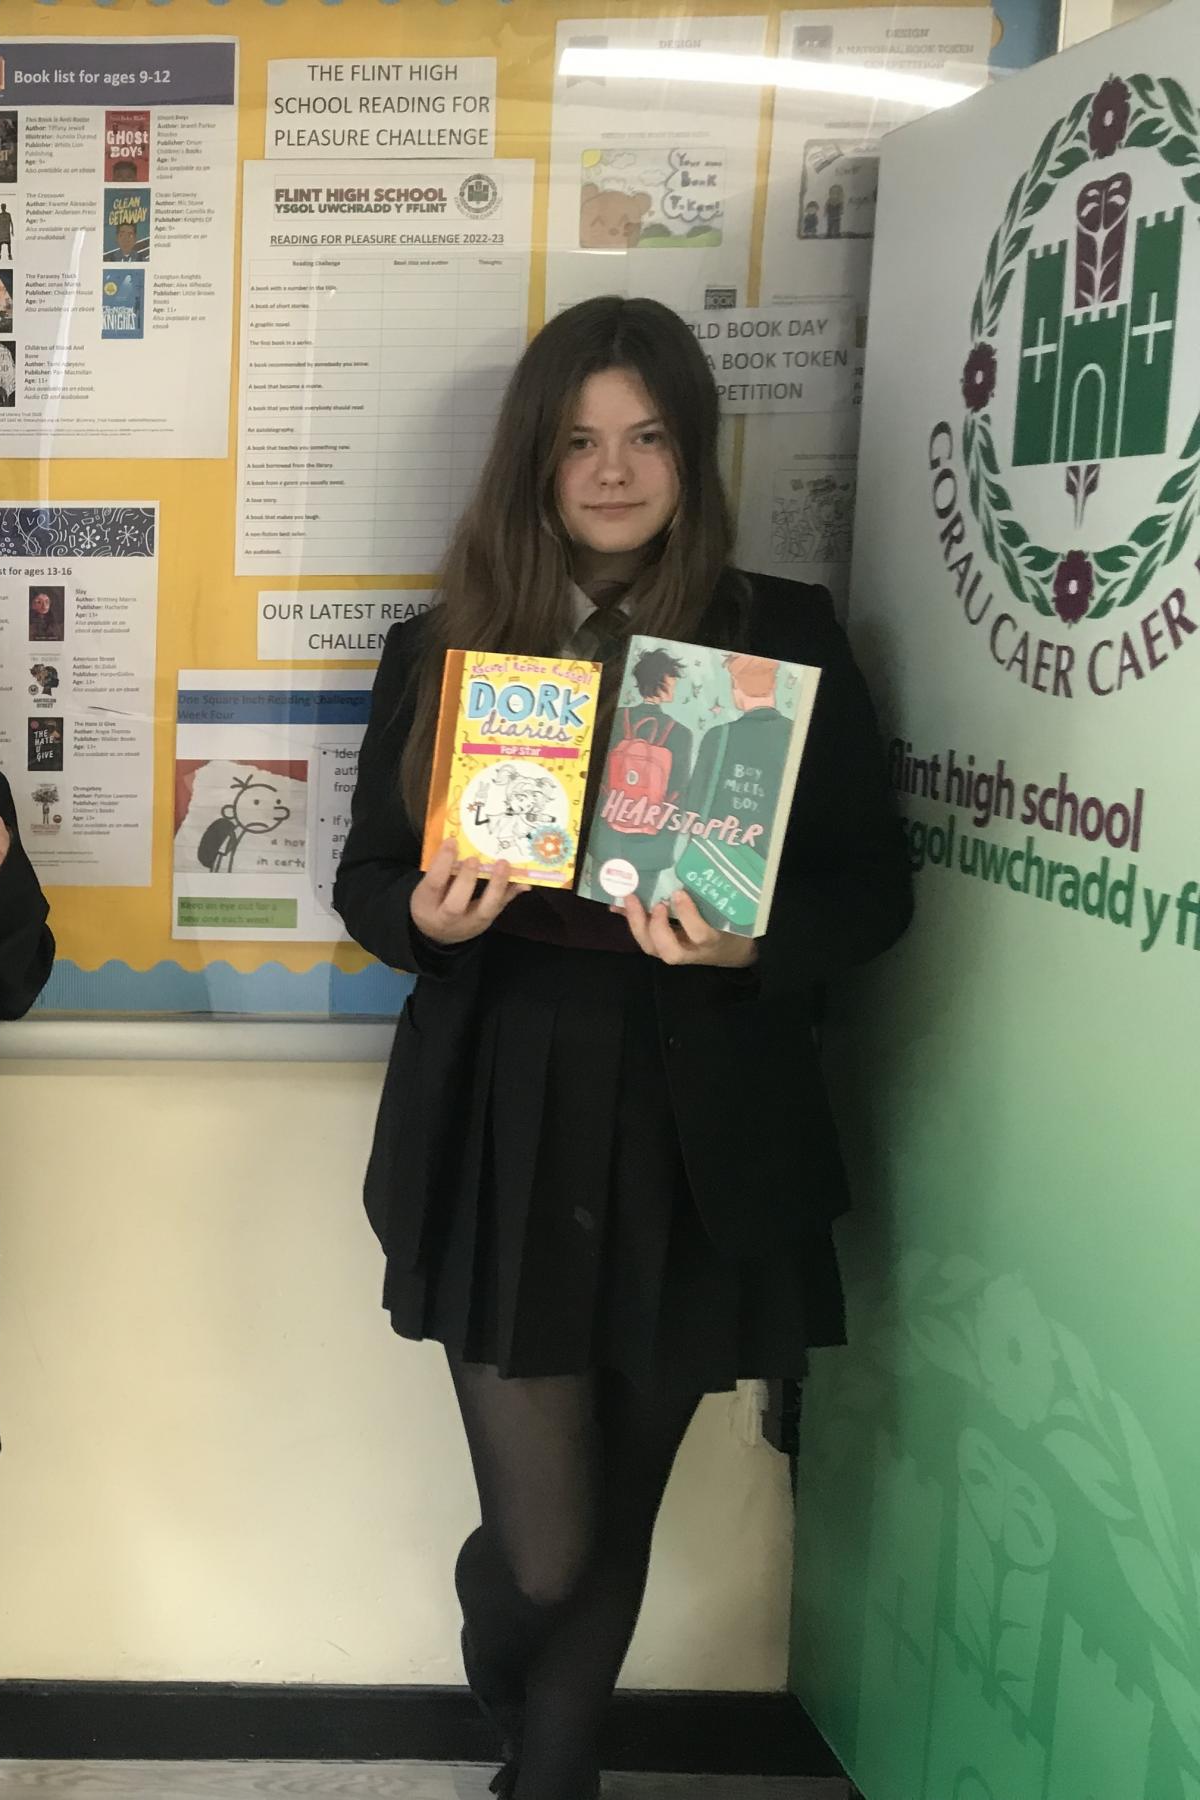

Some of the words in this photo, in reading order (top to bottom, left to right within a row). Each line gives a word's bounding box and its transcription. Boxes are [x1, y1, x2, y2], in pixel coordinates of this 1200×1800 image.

[14, 70, 50, 84] Book
[54, 70, 75, 84] list
[79, 70, 100, 84] for
[104, 73, 135, 86] ages
[139, 71, 171, 84] 9-12
[307, 65, 344, 81] THE
[350, 65, 404, 81] FLINT
[409, 65, 458, 81] HIGH
[274, 96, 352, 114] SCHOOL
[359, 96, 445, 113] READING
[452, 95, 490, 113] FOR
[274, 129, 369, 146] PLEASURE
[376, 128, 489, 146] CHALLENGE
[275, 188, 322, 202] FLINT
[326, 188, 369, 202] HIGH
[374, 188, 447, 202] SCHOOL
[109, 208, 148, 225] GETAWAY
[275, 203, 315, 213] YSGOL
[318, 203, 391, 213] UWCHRADD
[395, 203, 404, 213] Y
[406, 203, 447, 213] FFLINT
[270, 235, 318, 245] READING
[320, 235, 342, 245] FOR
[345, 234, 396, 244] PLEASURE
[399, 234, 461, 244] CHALLENGE
[463, 234, 504, 244] 2022-23
[728, 321, 783, 338] BOOK
[788, 319, 828, 337] DAY
[722, 353, 776, 370] BOOK
[783, 350, 848, 367] TOKEN
[929, 420, 993, 626] GORAU
[990, 613, 1074, 699] CAER
[1087, 588, 1199, 697] CAER
[8, 567, 22, 576] for
[24, 568, 45, 578] ages
[47, 567, 73, 576] 13-16
[263, 604, 303, 620] OUR
[309, 603, 375, 620] LATEST
[203, 695, 240, 706] Square
[267, 695, 310, 706] Reading
[467, 681, 590, 727] DORK
[480, 709, 573, 742] diaries
[33, 730, 49, 739] THE
[34, 736, 54, 746] HATE
[37, 751, 54, 763] GIVE
[945, 749, 1015, 828] high
[1020, 771, 1145, 853] school
[600, 790, 764, 847] HEARTSTOPPER
[702, 868, 738, 899] ALICE
[686, 871, 737, 917] OSEMAN
[959, 835, 1137, 928] uwchradd
[1141, 887, 1170, 952] y
